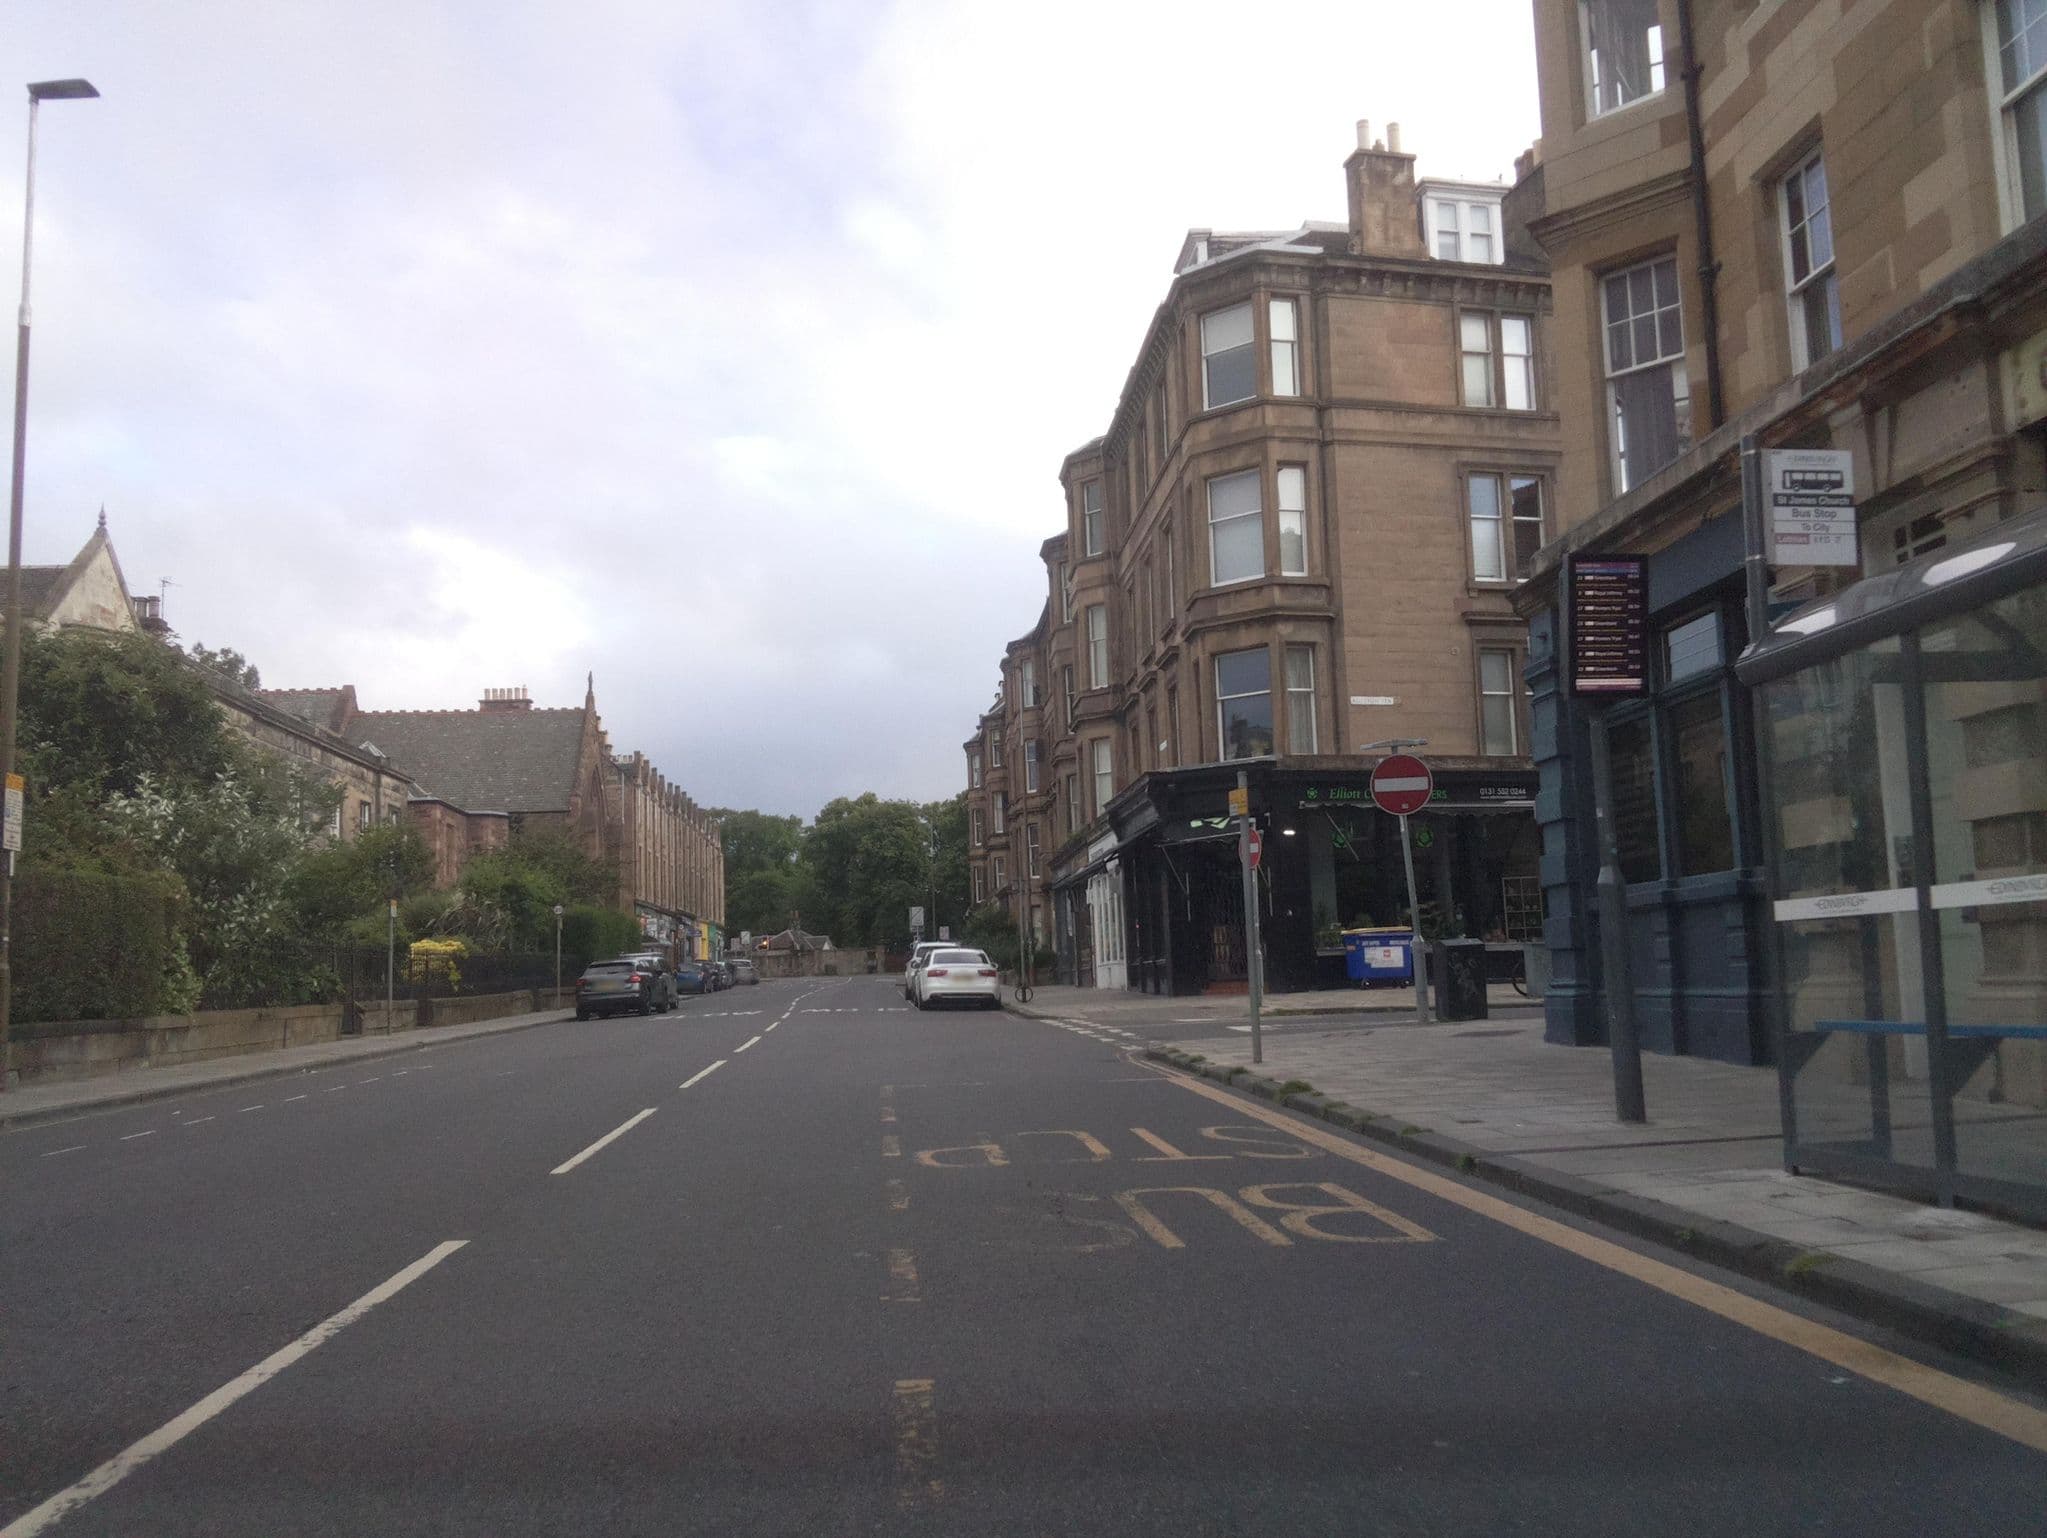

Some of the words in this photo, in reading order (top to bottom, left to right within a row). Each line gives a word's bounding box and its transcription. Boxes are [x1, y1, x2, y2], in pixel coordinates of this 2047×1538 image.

[1792, 508, 1811, 518] Bus
[1814, 508, 1837, 519] Stop
[1479, 787, 1495, 795] 0131
